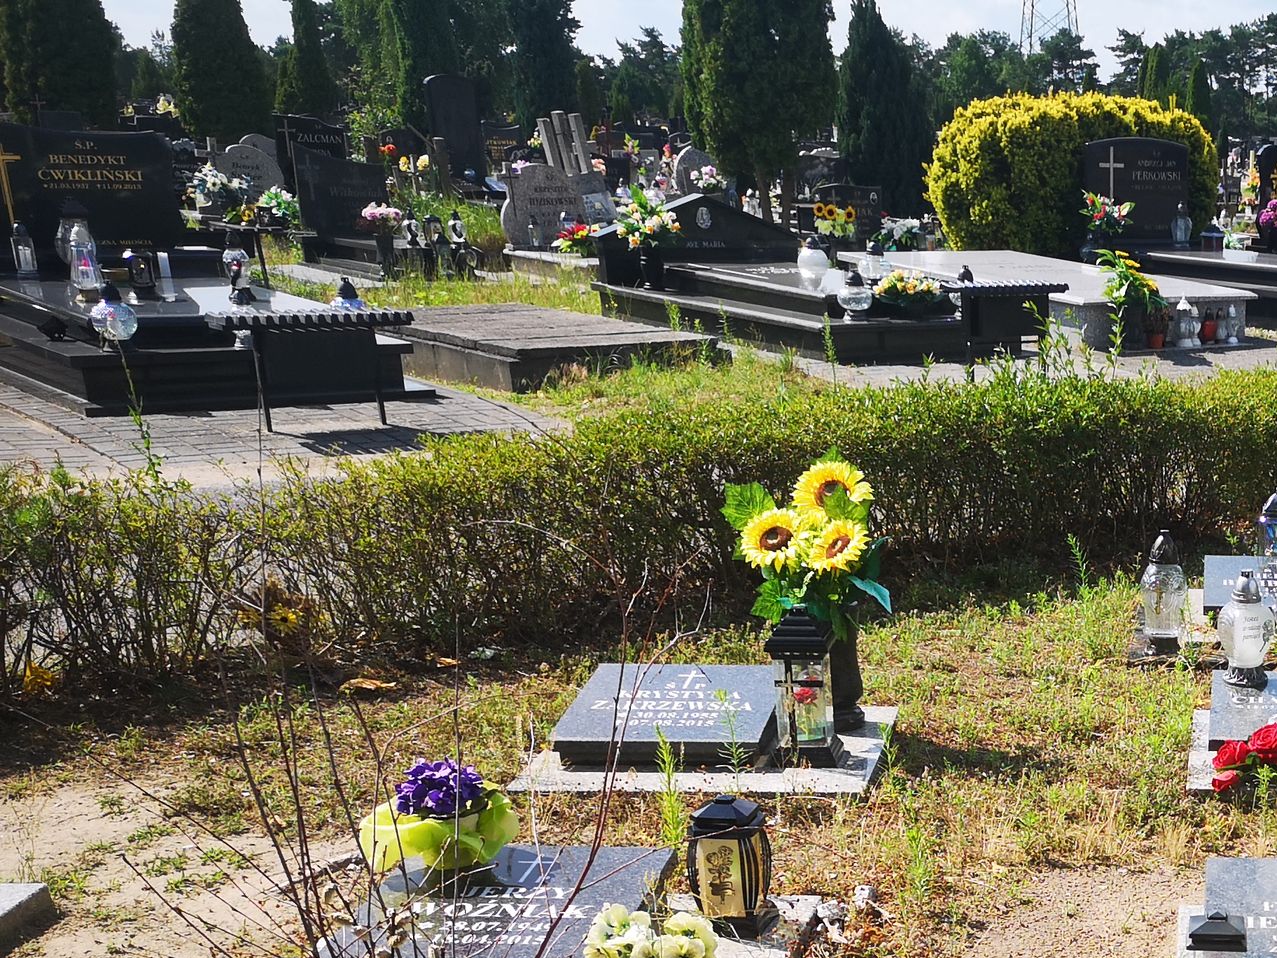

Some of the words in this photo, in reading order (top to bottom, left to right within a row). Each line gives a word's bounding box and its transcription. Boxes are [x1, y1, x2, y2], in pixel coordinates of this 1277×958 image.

[74, 138, 98, 150] Ś.P.
[297, 133, 343, 144] ZALCMAN
[50, 154, 127, 165] BENEDYKT
[38, 166, 144, 182] ĆWIKLIŃSKI
[1132, 170, 1181, 181] PERKOWSKI
[702, 241, 726, 249] MARIA
[618, 689, 742, 699] KRYSTYA
[460, 886, 573, 899] JERZY
[412, 900, 595, 919] WOŹNIAK
